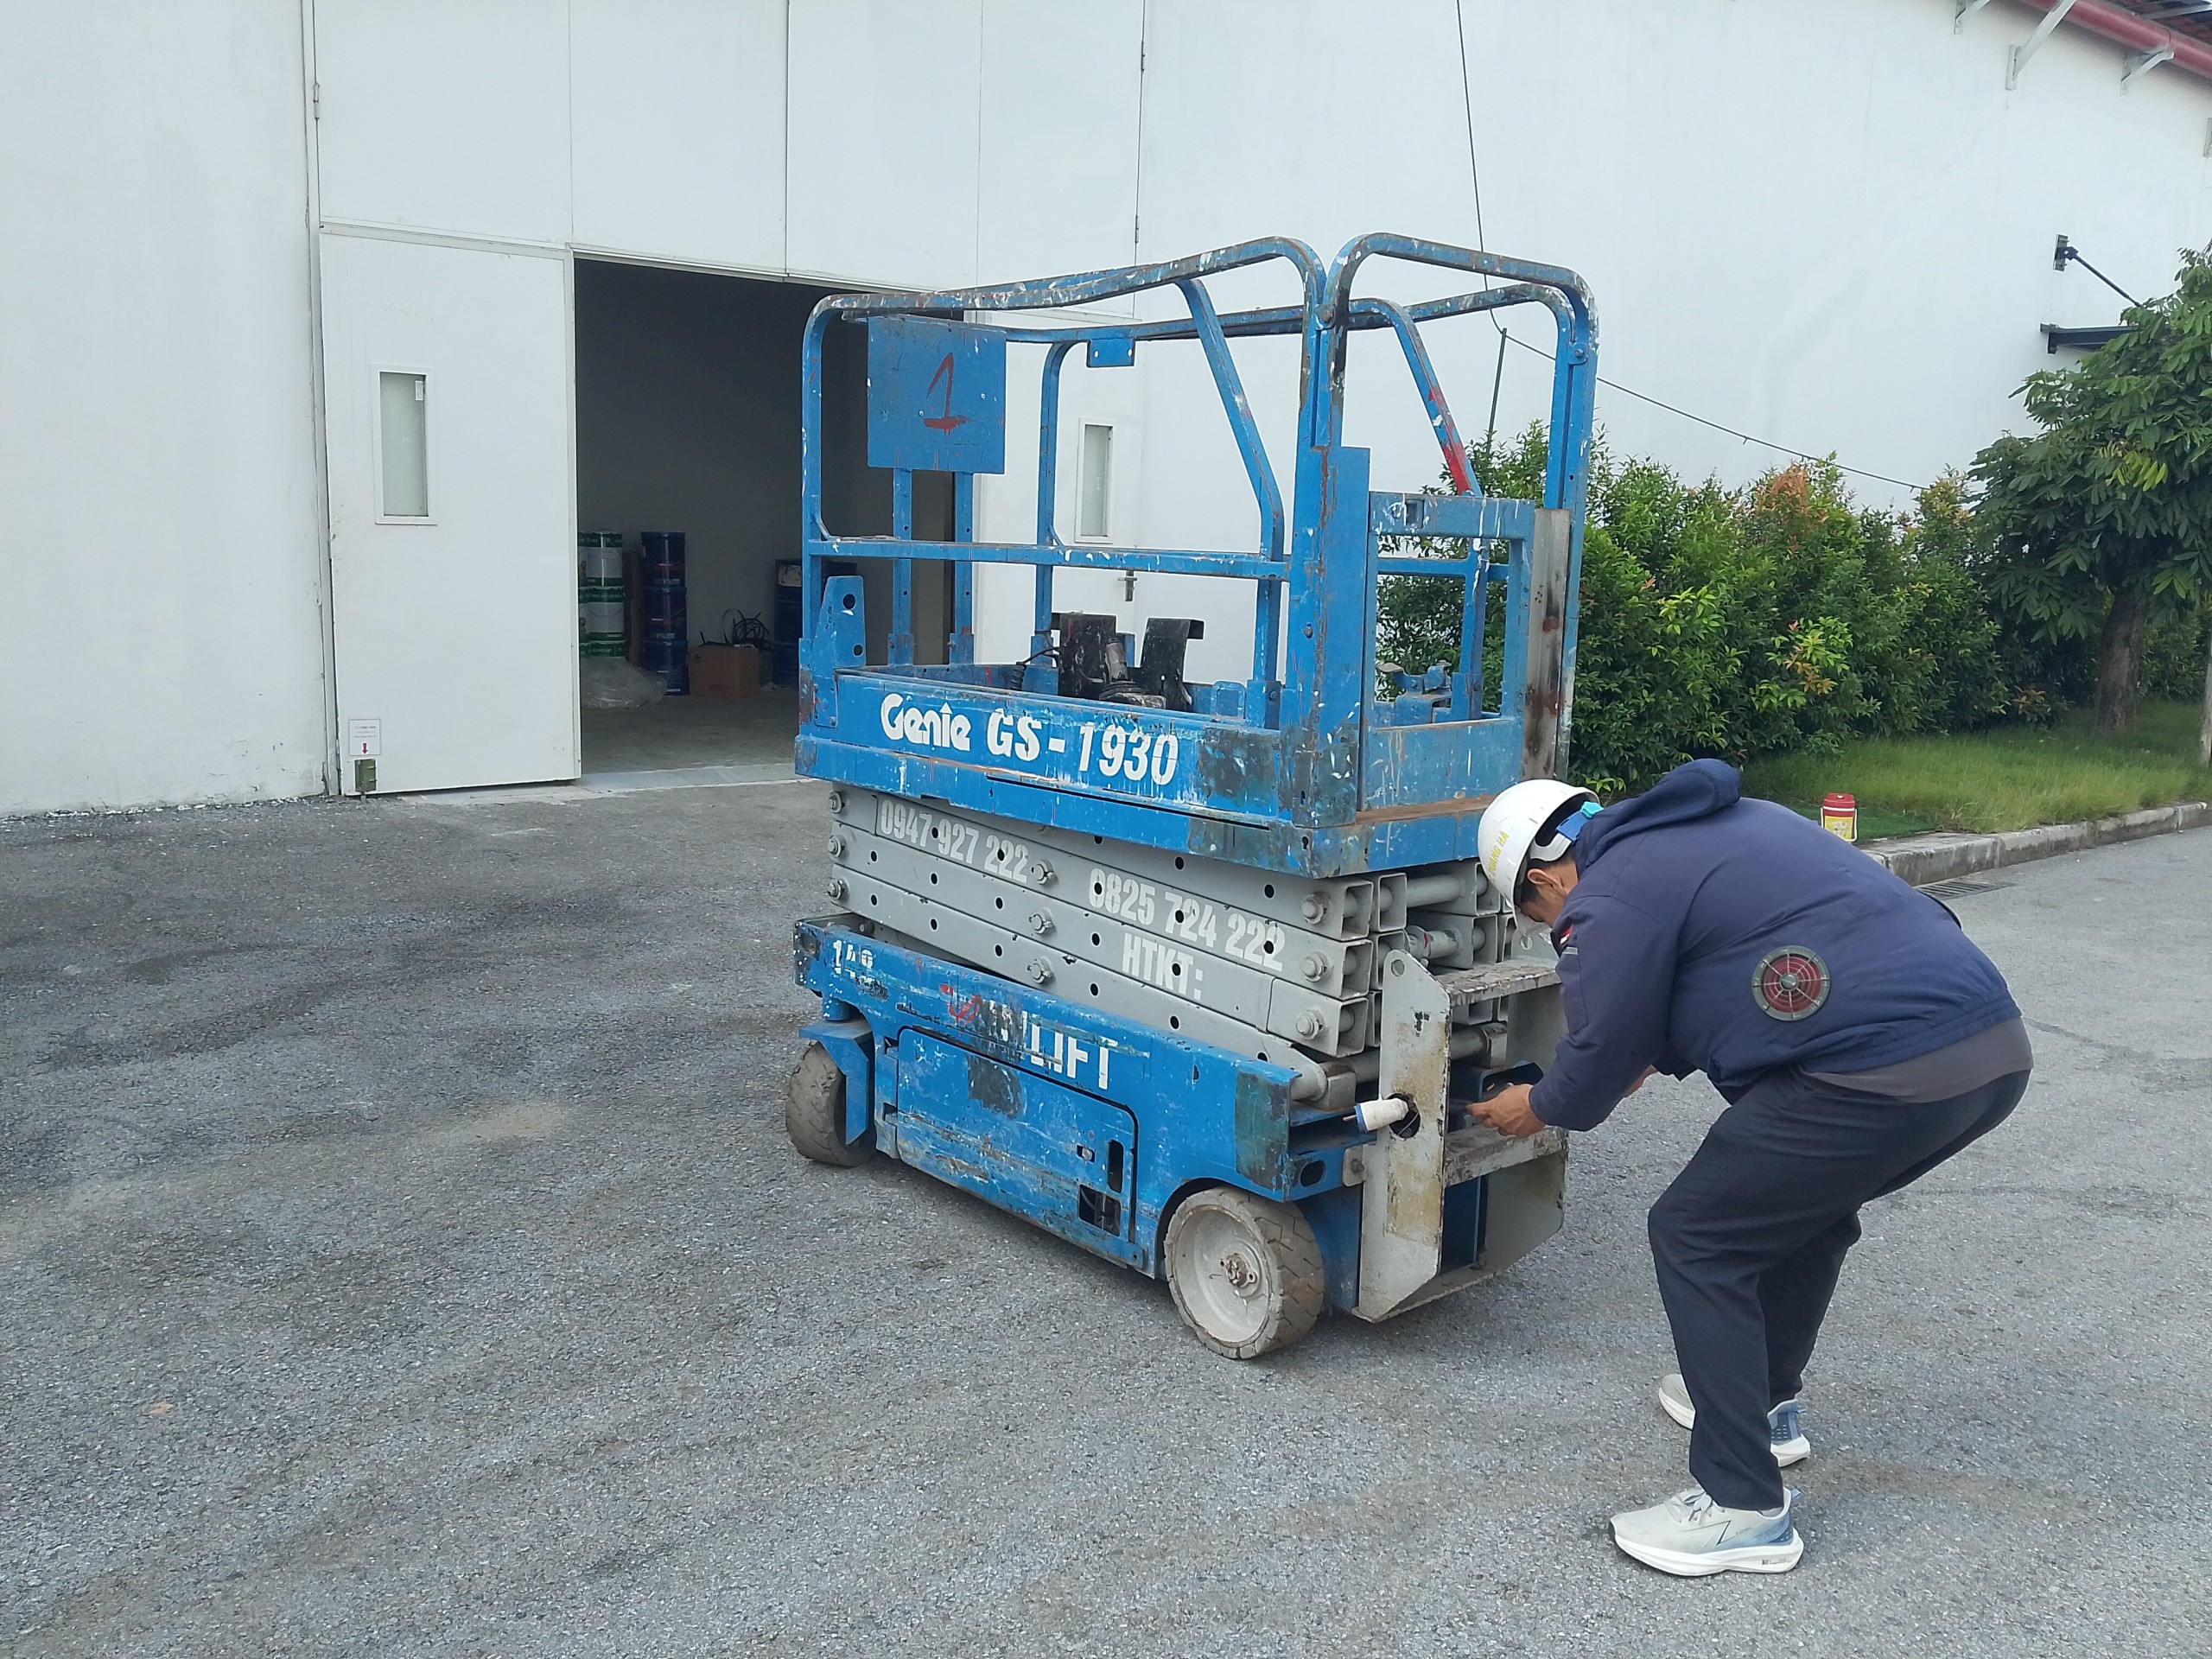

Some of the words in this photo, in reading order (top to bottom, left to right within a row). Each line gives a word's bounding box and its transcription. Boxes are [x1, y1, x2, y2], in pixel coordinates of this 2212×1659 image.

[880, 693, 971, 752] Genie
[987, 708, 1042, 761] GS
[1079, 721, 1179, 785] 1930
[880, 799, 933, 848] 0947
[938, 818, 980, 864] 927
[984, 835, 1029, 884] 222
[1089, 868, 1156, 925] 0825
[1165, 891, 1217, 949] 724
[1225, 912, 1286, 972] 222
[1122, 932, 1204, 1001] HTKT:
